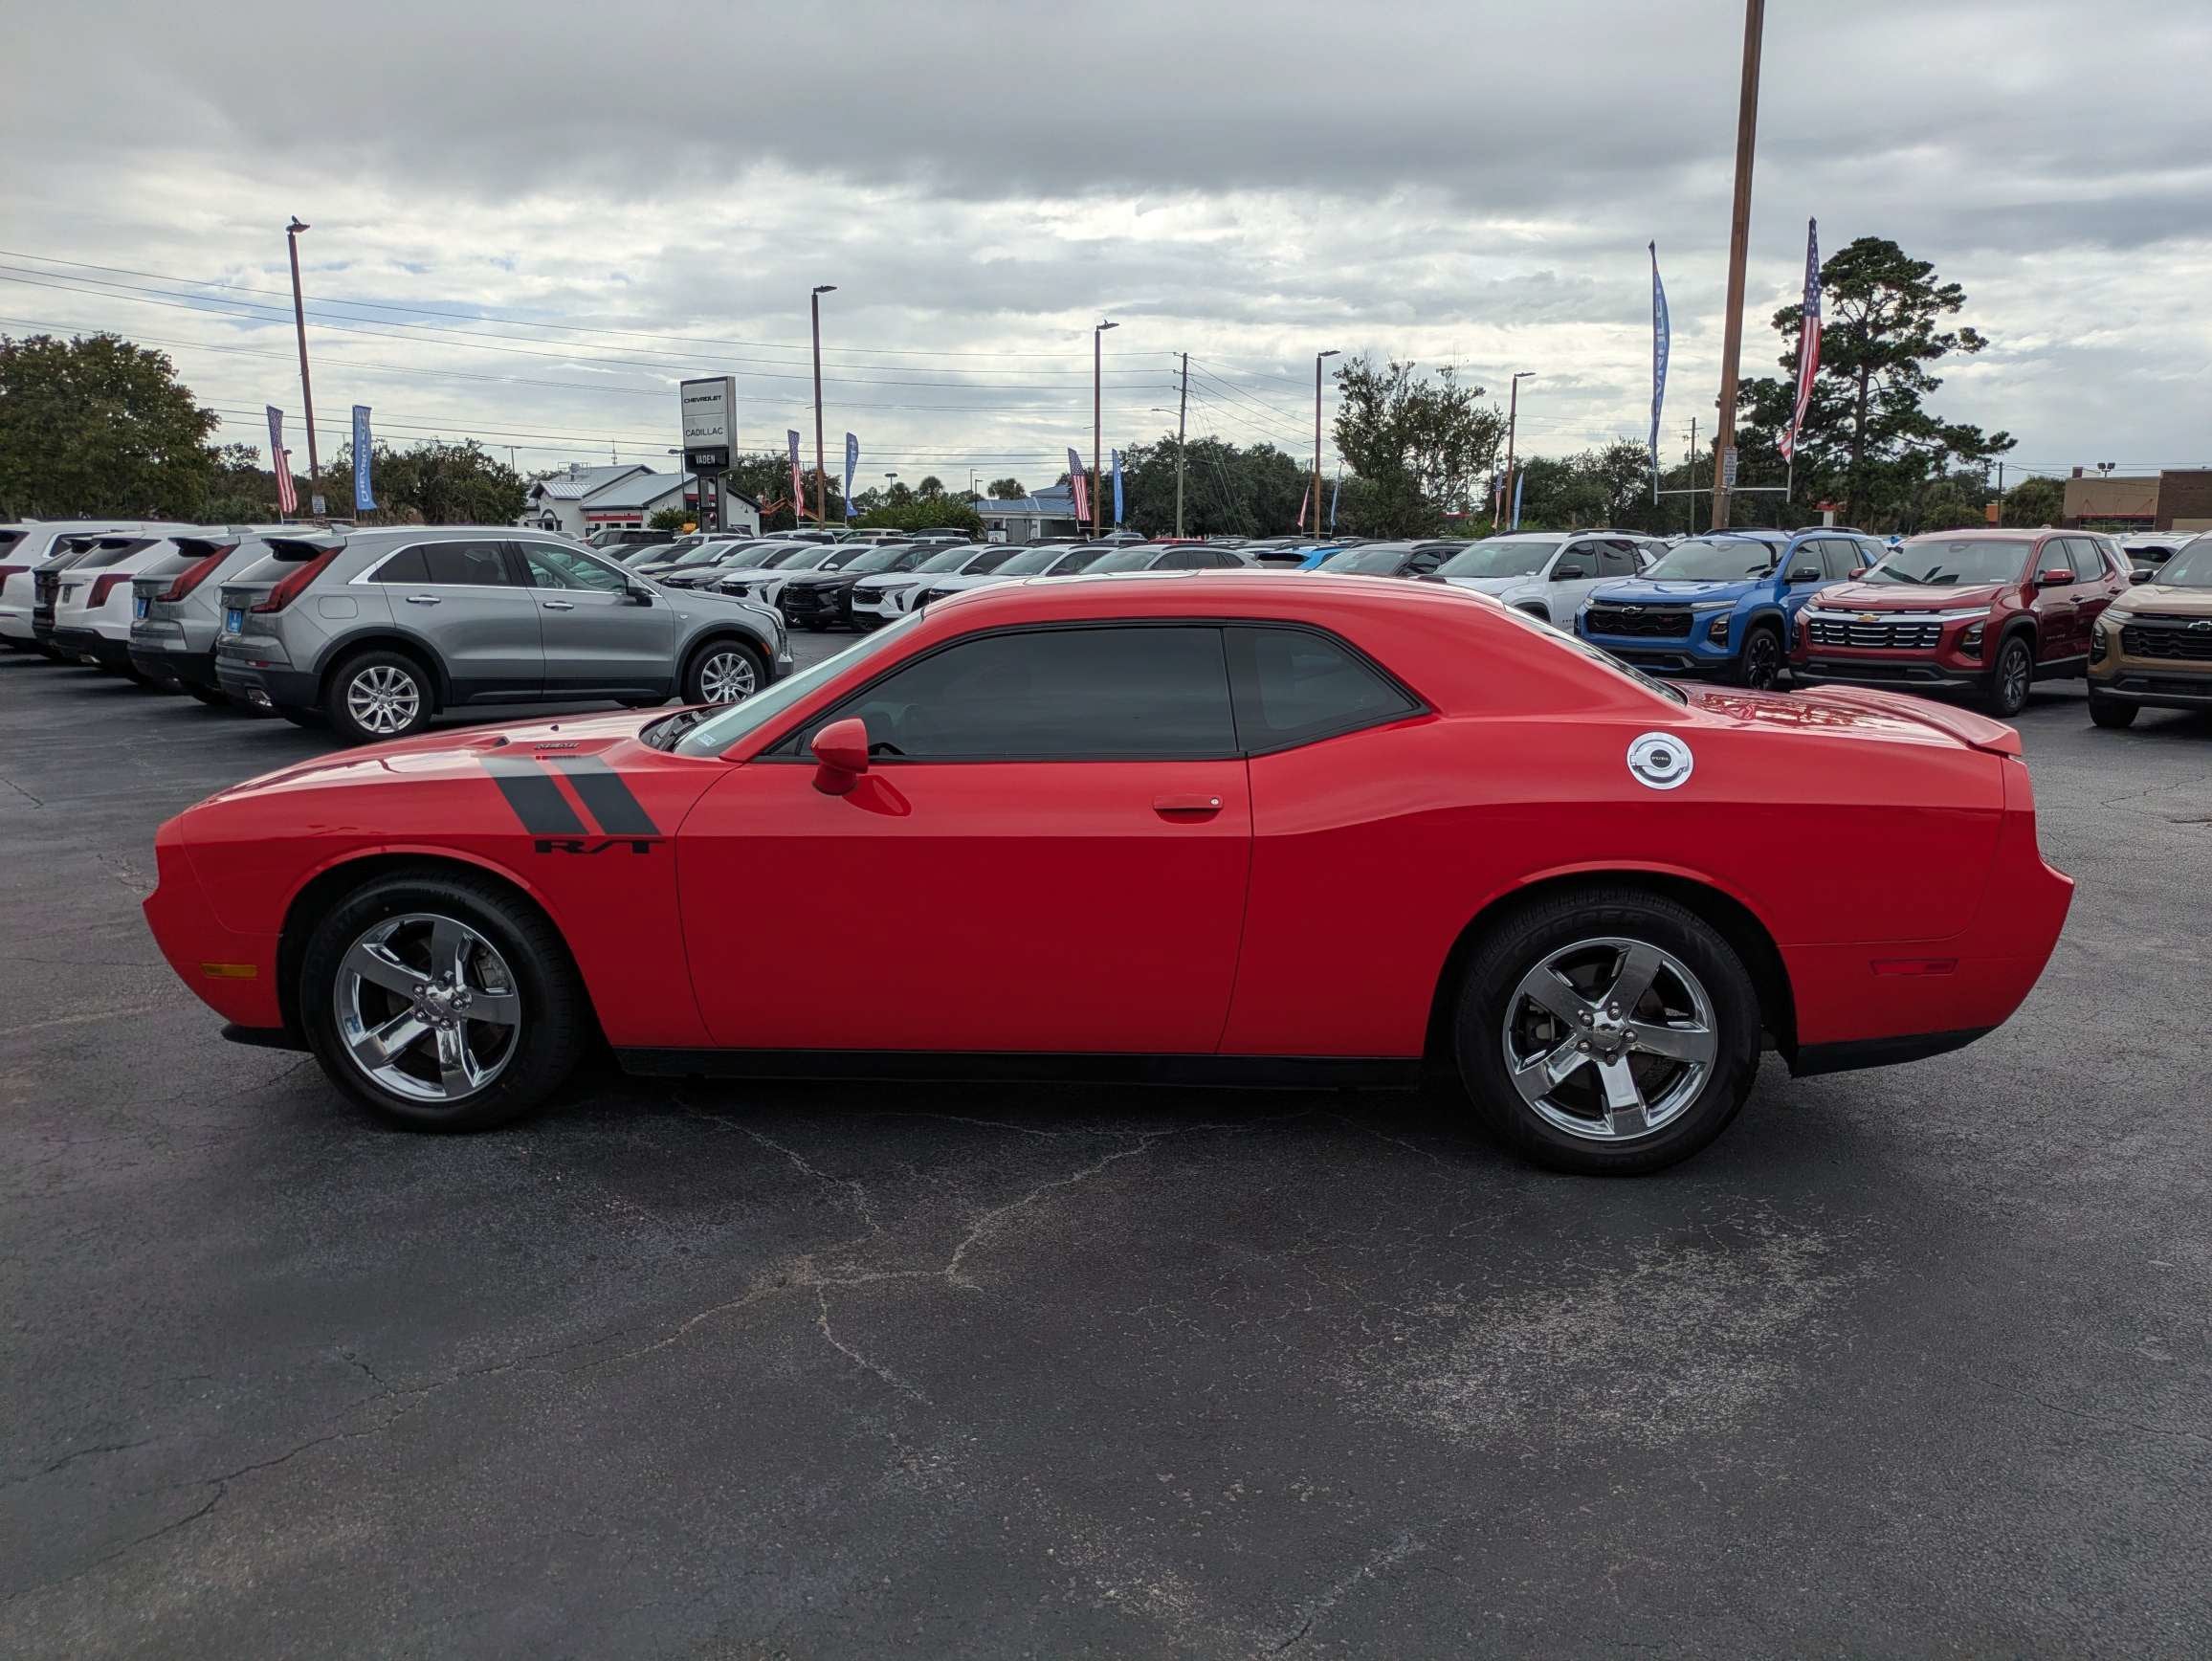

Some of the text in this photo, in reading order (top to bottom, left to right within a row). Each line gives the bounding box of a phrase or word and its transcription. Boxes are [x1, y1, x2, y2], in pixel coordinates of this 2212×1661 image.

[685, 427, 723, 437] CADILLAC
[696, 454, 716, 465] VADEN
[535, 839, 666, 853] R/T
